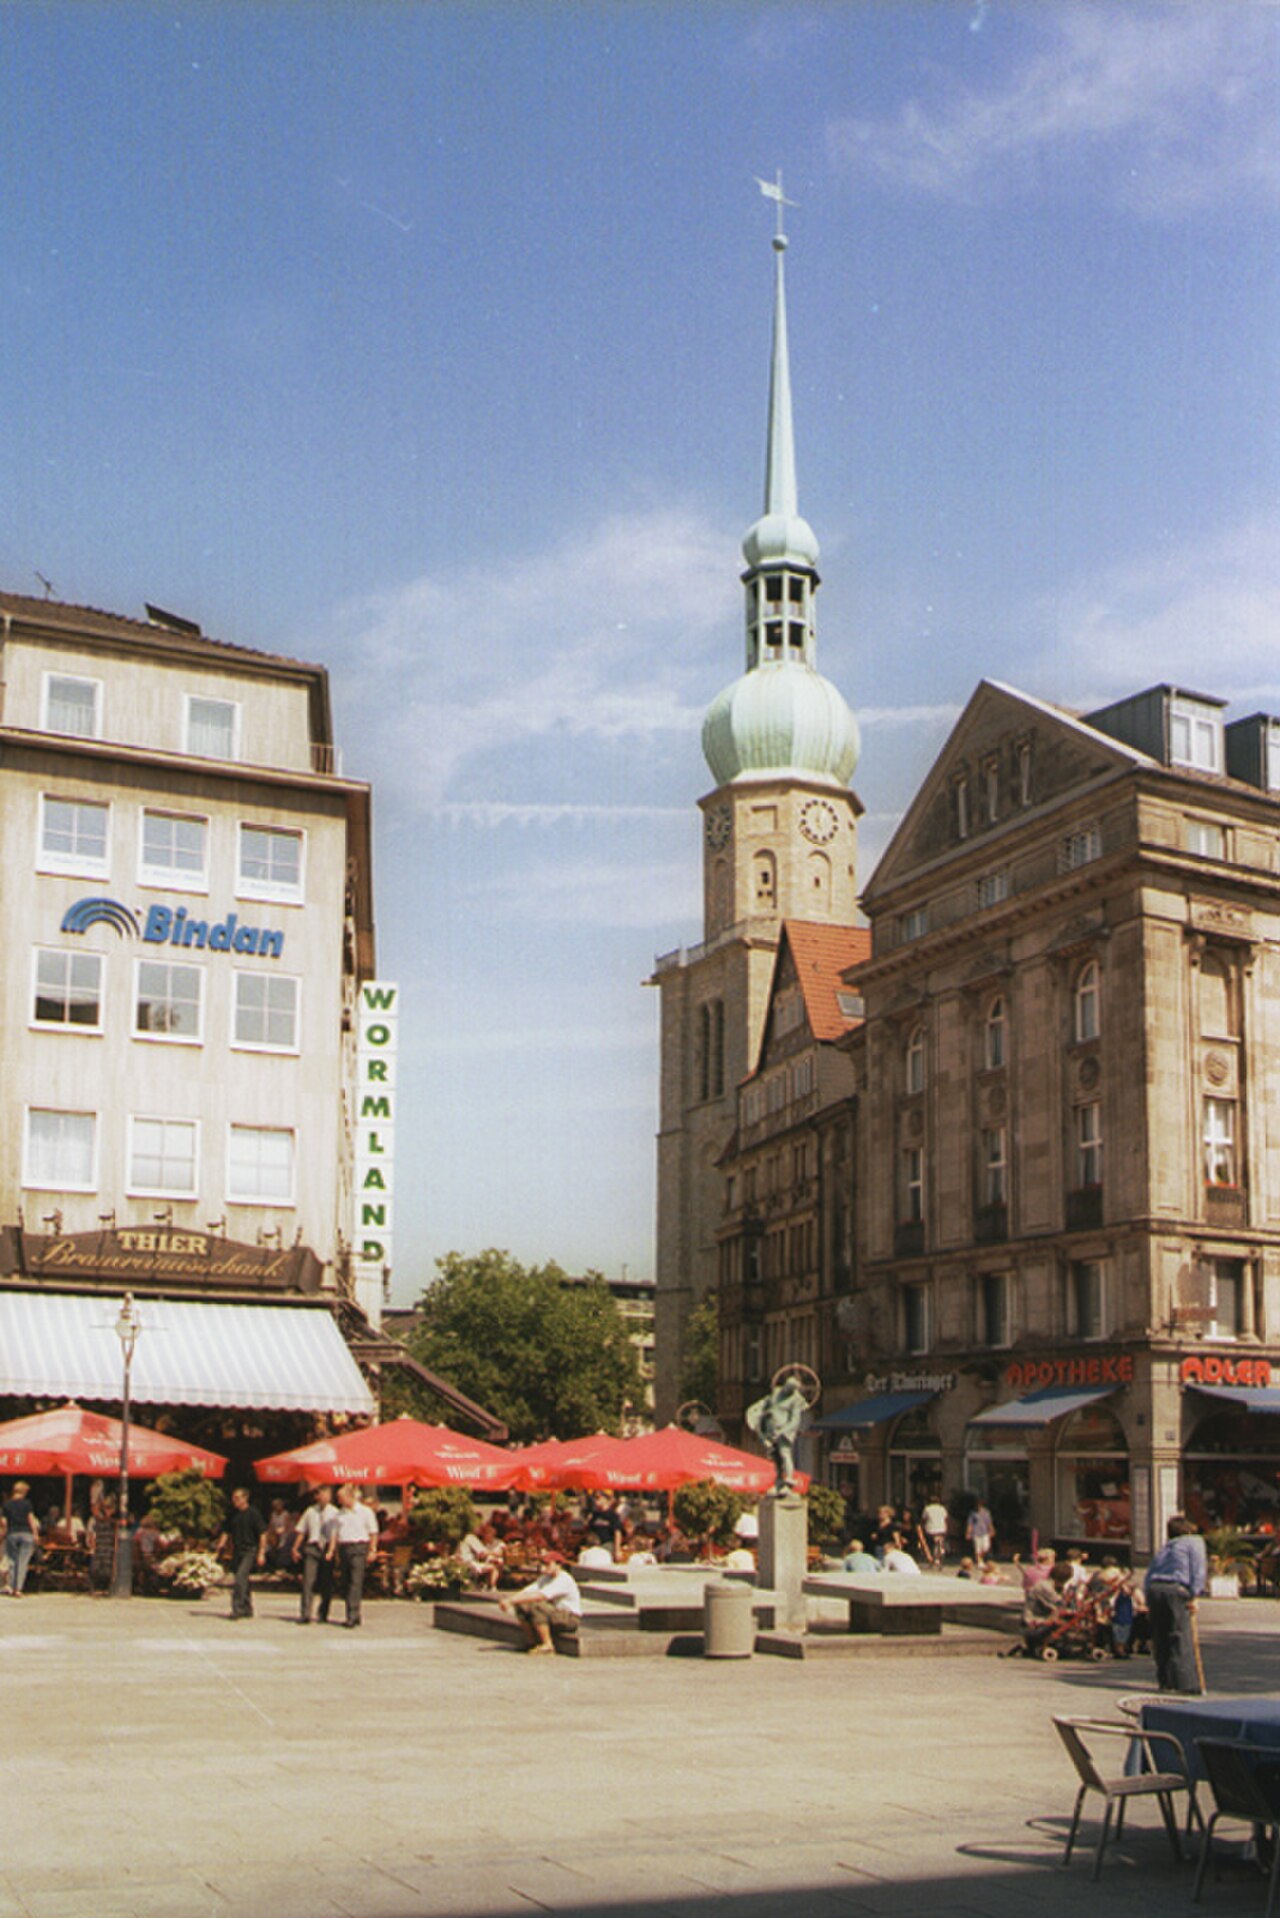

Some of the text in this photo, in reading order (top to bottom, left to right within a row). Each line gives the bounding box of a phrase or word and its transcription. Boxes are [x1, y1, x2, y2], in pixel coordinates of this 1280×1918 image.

[143, 903, 285, 959] Bindan
[361, 988, 396, 1262] WORMLAND
[117, 1231, 208, 1255] THIER
[1006, 1356, 1134, 1387] APOTHEKE
[1181, 1356, 1272, 1386] ADLER
